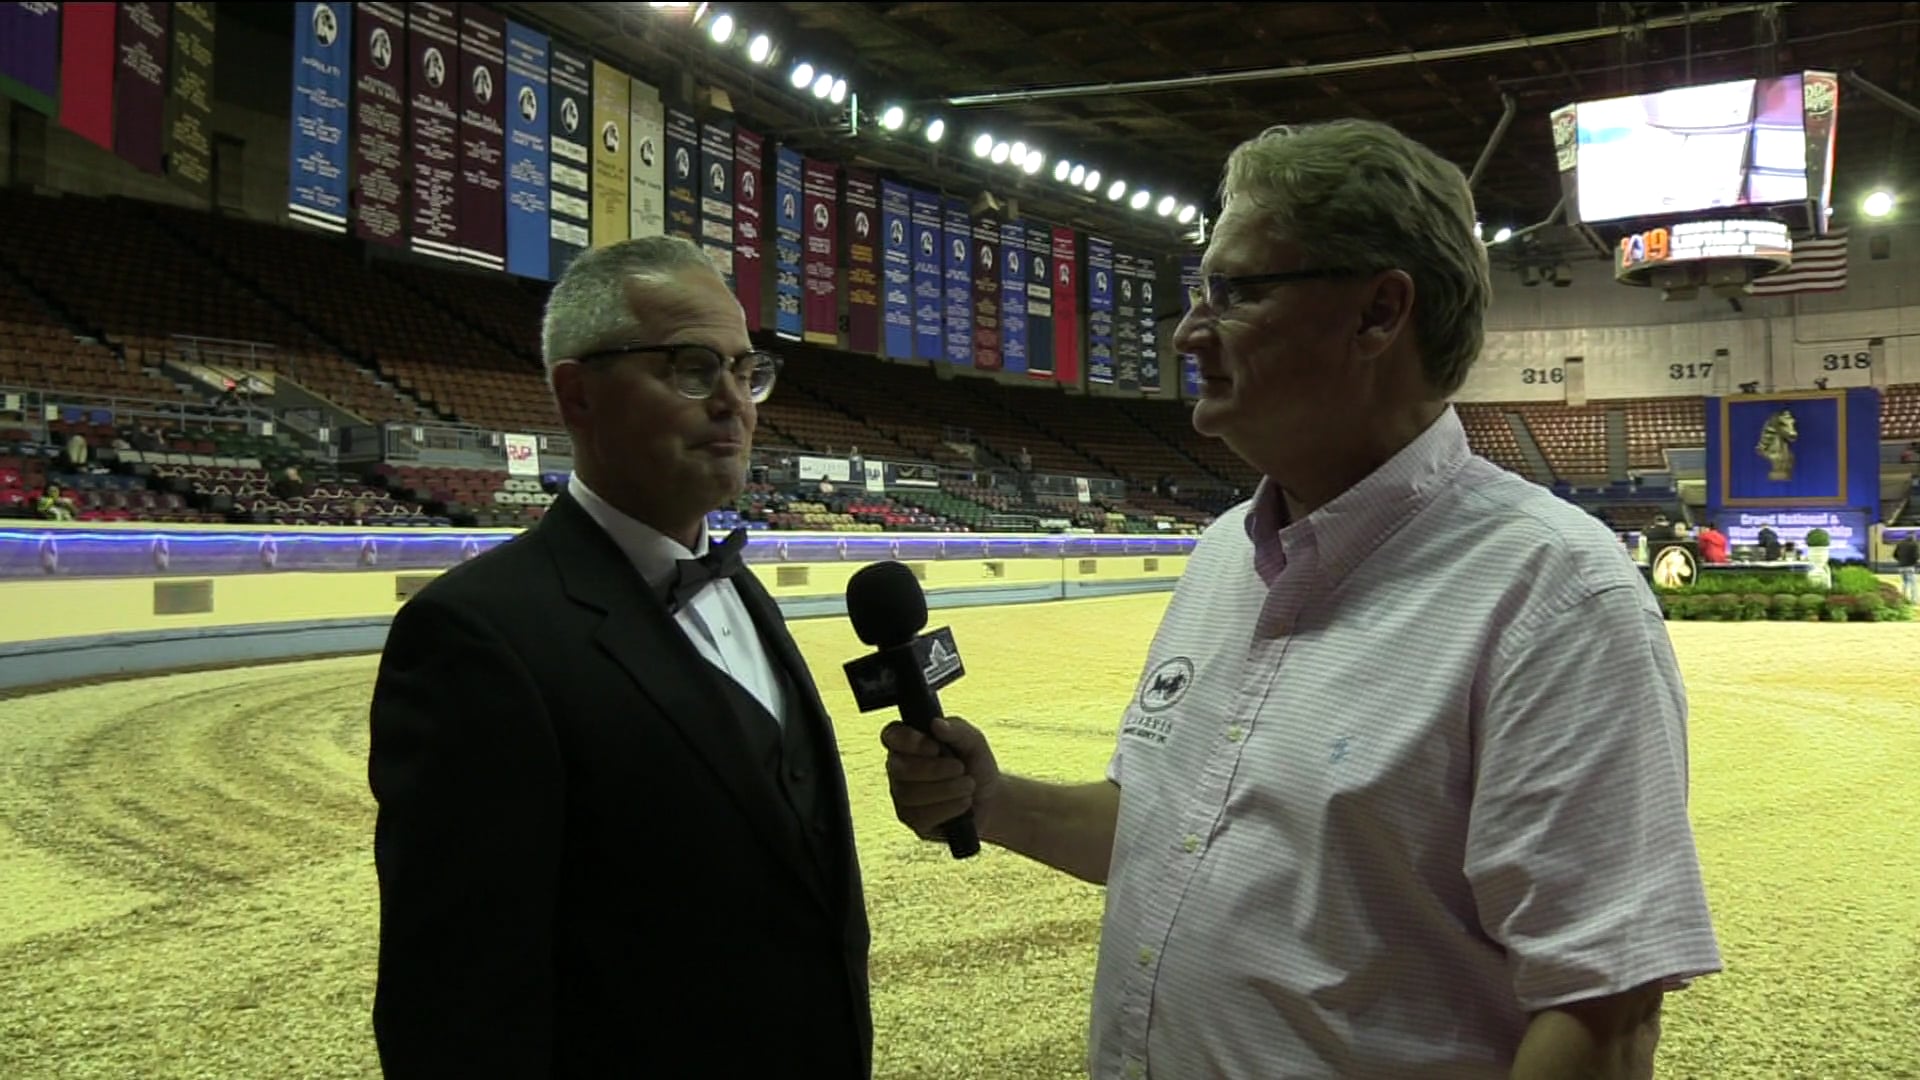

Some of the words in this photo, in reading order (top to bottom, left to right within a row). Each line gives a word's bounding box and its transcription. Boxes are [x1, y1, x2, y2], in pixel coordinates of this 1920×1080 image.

[1823, 352, 1871, 371] 318
[1522, 367, 1563, 384] 316
[1669, 362, 1713, 380] 317
